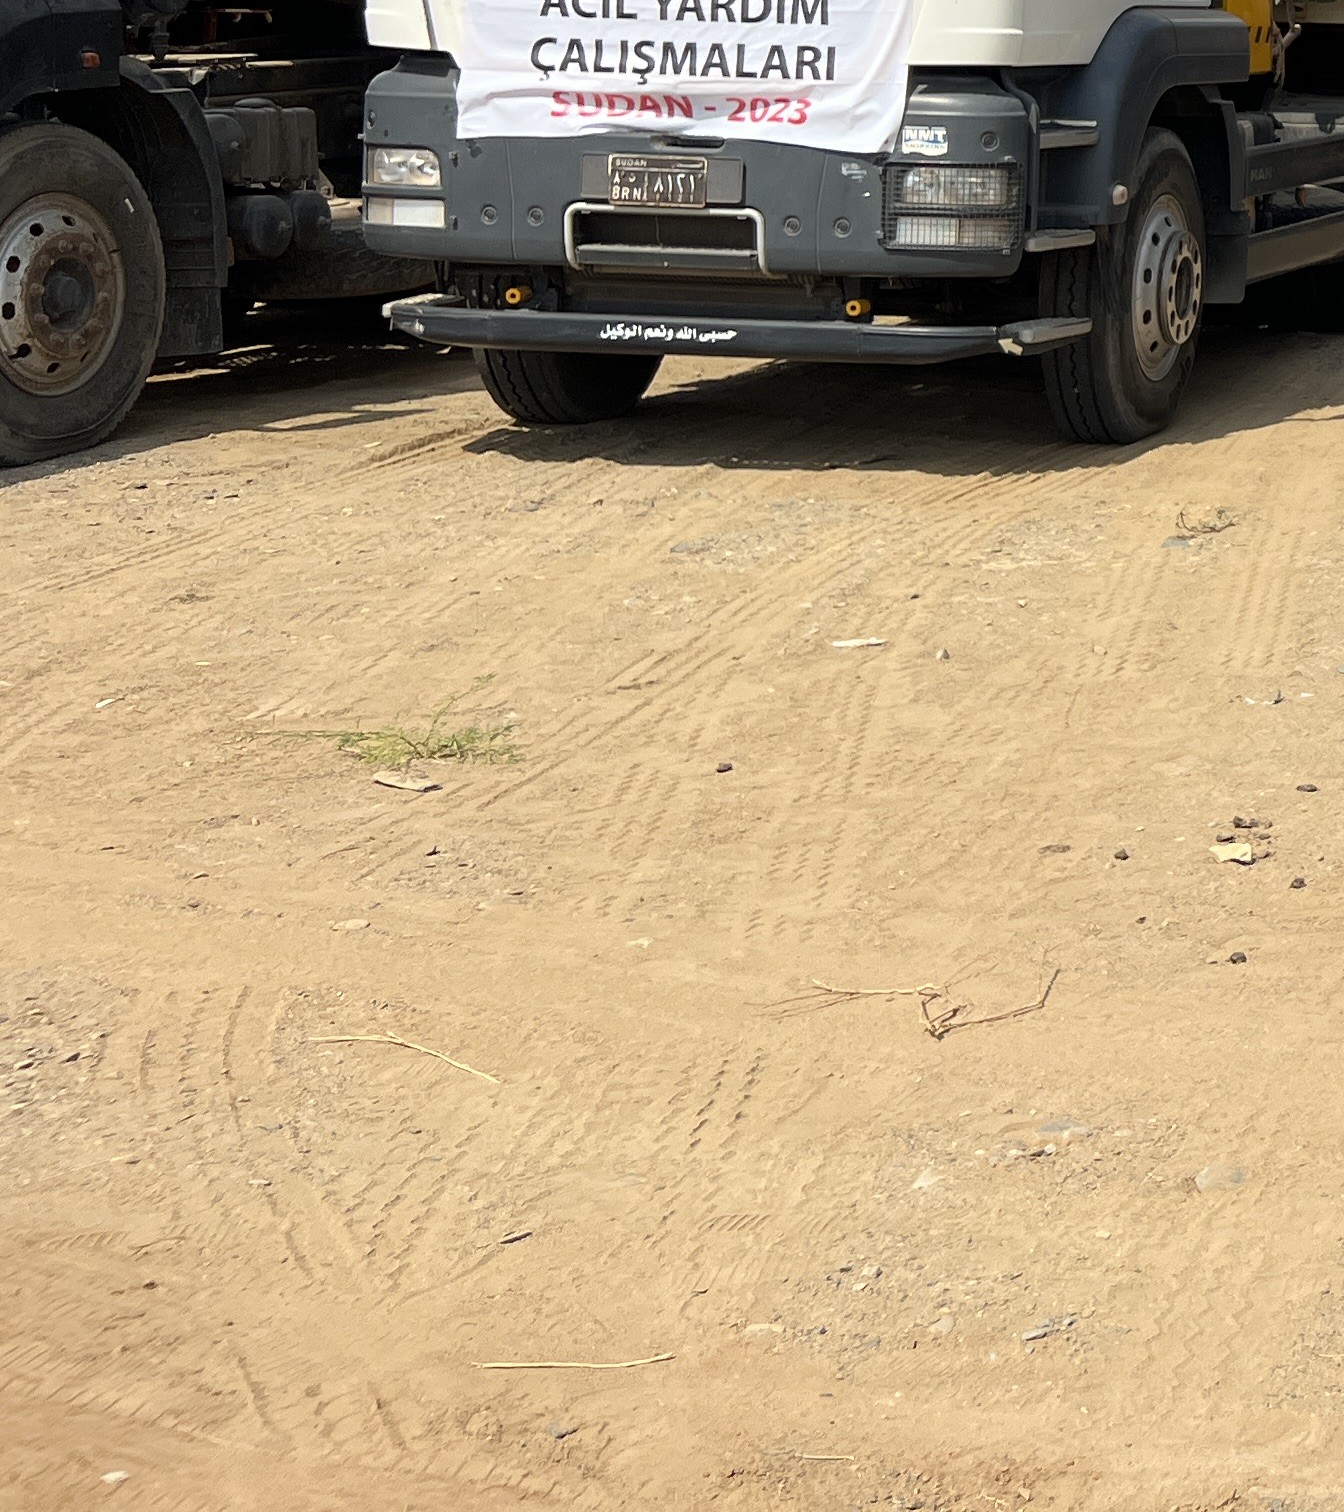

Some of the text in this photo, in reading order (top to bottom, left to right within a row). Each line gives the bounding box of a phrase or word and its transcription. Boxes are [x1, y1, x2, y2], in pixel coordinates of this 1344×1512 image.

[530, 37, 836, 85] ÇALIŞMALARI
[550, 90, 693, 119] SUDAN
[726, 97, 812, 125] 2023
[905, 128, 947, 143] NMT
[675, 326, 697, 340] الله
